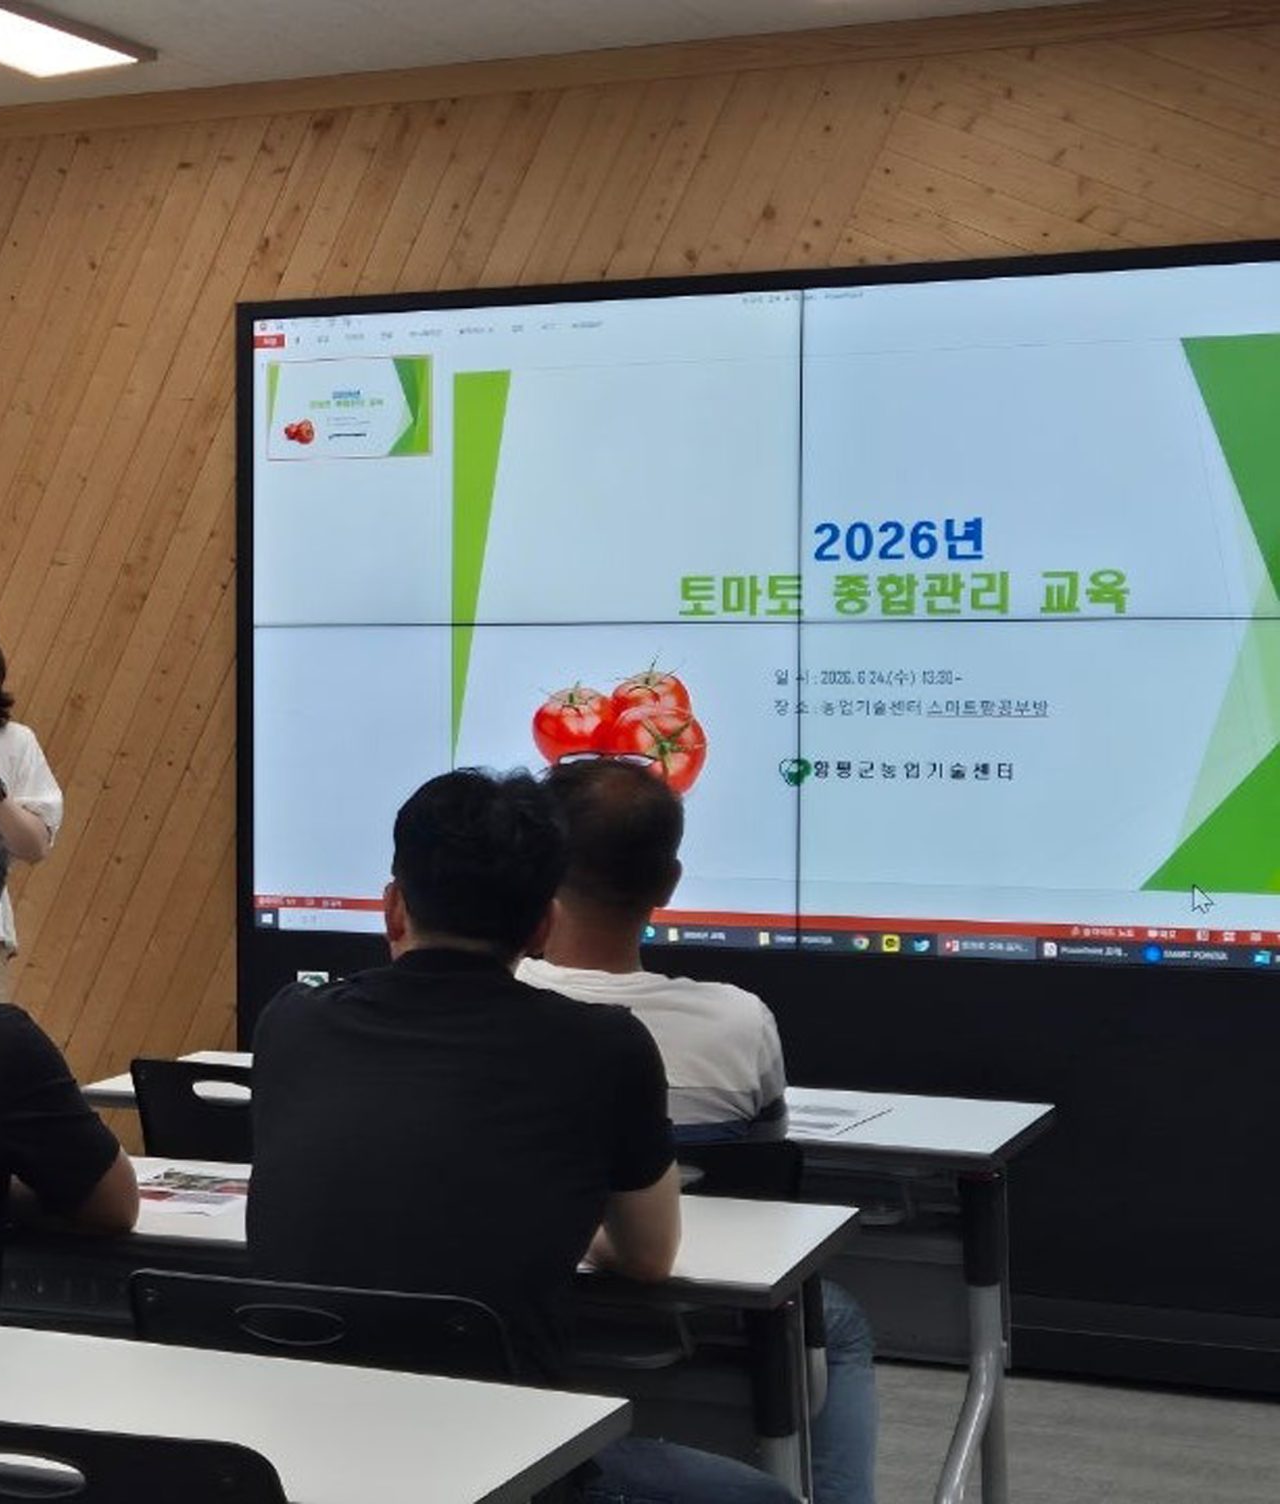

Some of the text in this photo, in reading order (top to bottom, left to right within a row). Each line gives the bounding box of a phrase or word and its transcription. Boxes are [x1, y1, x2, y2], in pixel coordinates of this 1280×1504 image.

[813, 517, 984, 562] 2026년
[678, 569, 1130, 616] 토마토 종합관리 교육
[774, 669, 789, 685] 일
[774, 700, 790, 716] 장
[822, 700, 922, 717] 농업기술센터
